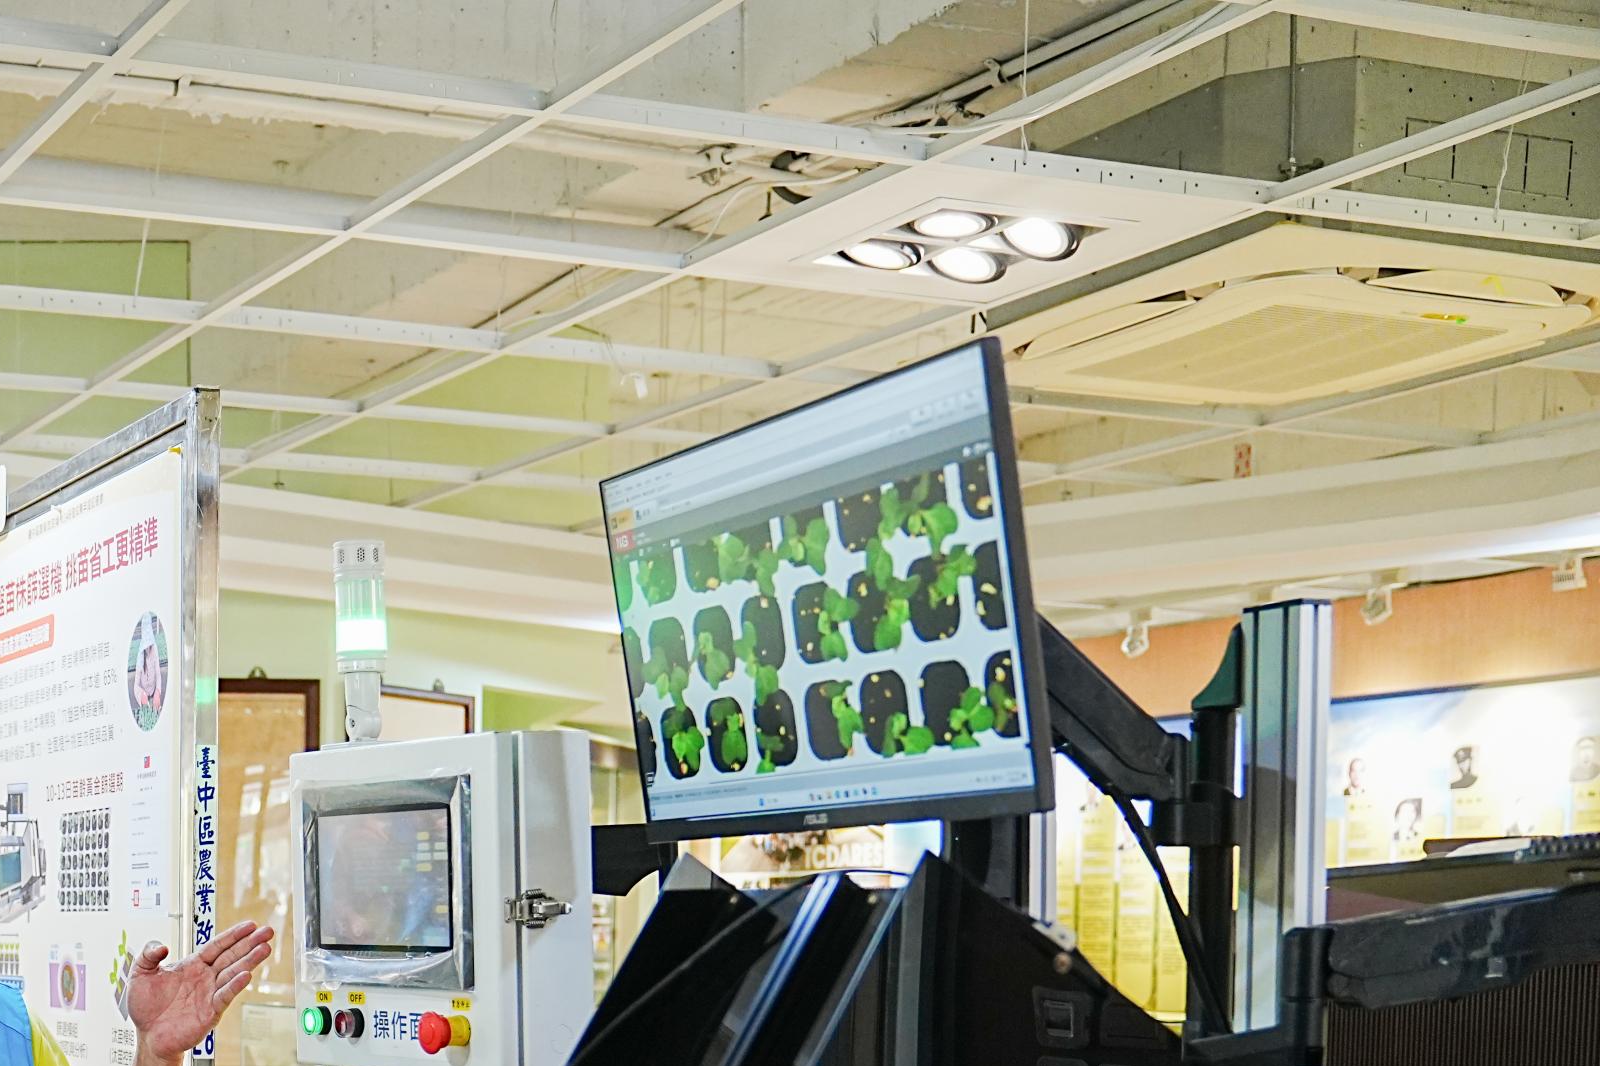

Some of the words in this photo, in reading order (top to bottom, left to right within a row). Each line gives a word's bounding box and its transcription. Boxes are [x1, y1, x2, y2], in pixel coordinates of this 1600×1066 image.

[65, 515, 159, 593] 挑苗省工更精準
[803, 843, 884, 869] TCDARES
[318, 992, 329, 1002] ON
[349, 993, 363, 1003] OFF
[373, 1010, 422, 1041] 操作面
